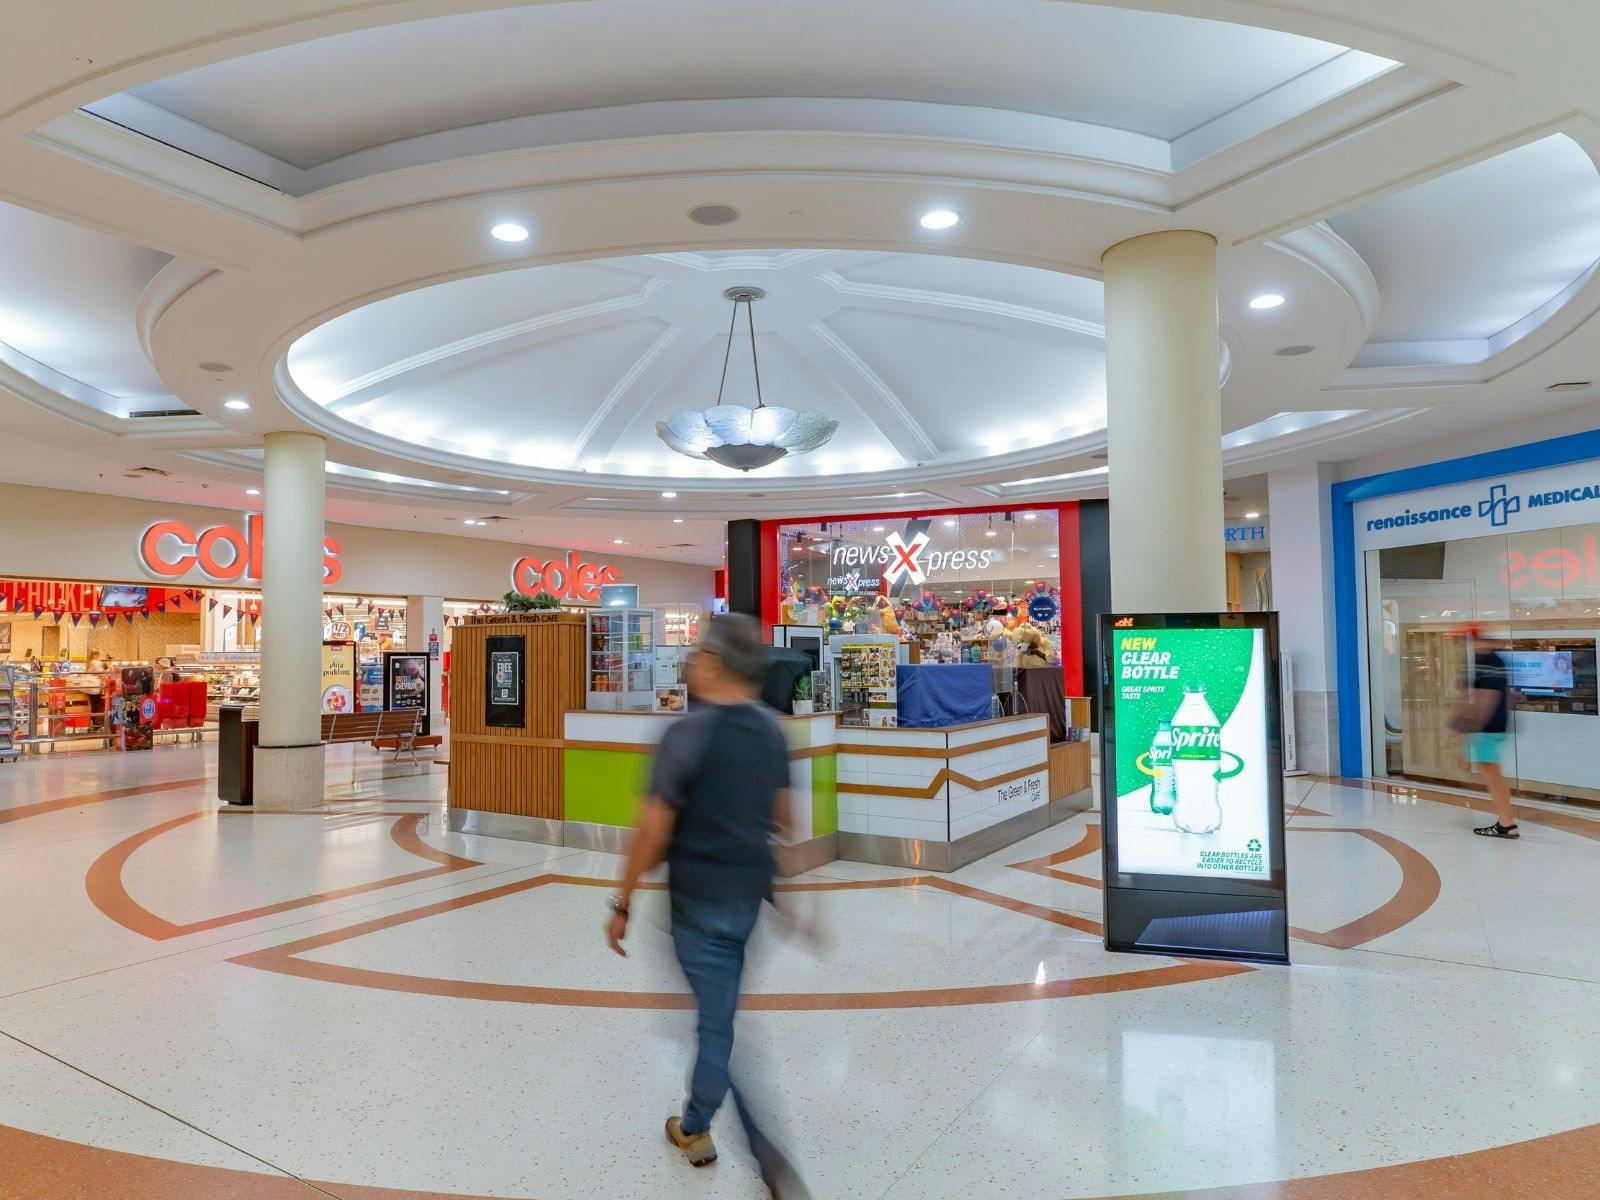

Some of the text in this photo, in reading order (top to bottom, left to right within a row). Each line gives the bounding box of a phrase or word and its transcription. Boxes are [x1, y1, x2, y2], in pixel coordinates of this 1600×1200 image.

[1367, 485, 1600, 531] renaissance MEDICAL
[1224, 526, 1265, 541] RTH
[140, 513, 342, 585] cols
[512, 551, 621, 602] coles
[471, 616, 484, 625] The
[485, 616, 509, 624] Green
[512, 614, 517, 623] &
[519, 613, 540, 623] Fresh
[1121, 637, 1157, 650] NEW
[1121, 651, 1171, 665] CLEAR
[1121, 665, 1180, 679] BOTTLE
[1171, 726, 1220, 752] Sprite
[1149, 746, 1172, 761] Spri
[998, 789, 1008, 803] The
[1008, 785, 1023, 799] Green
[1213, 863, 1234, 871] OTHER
